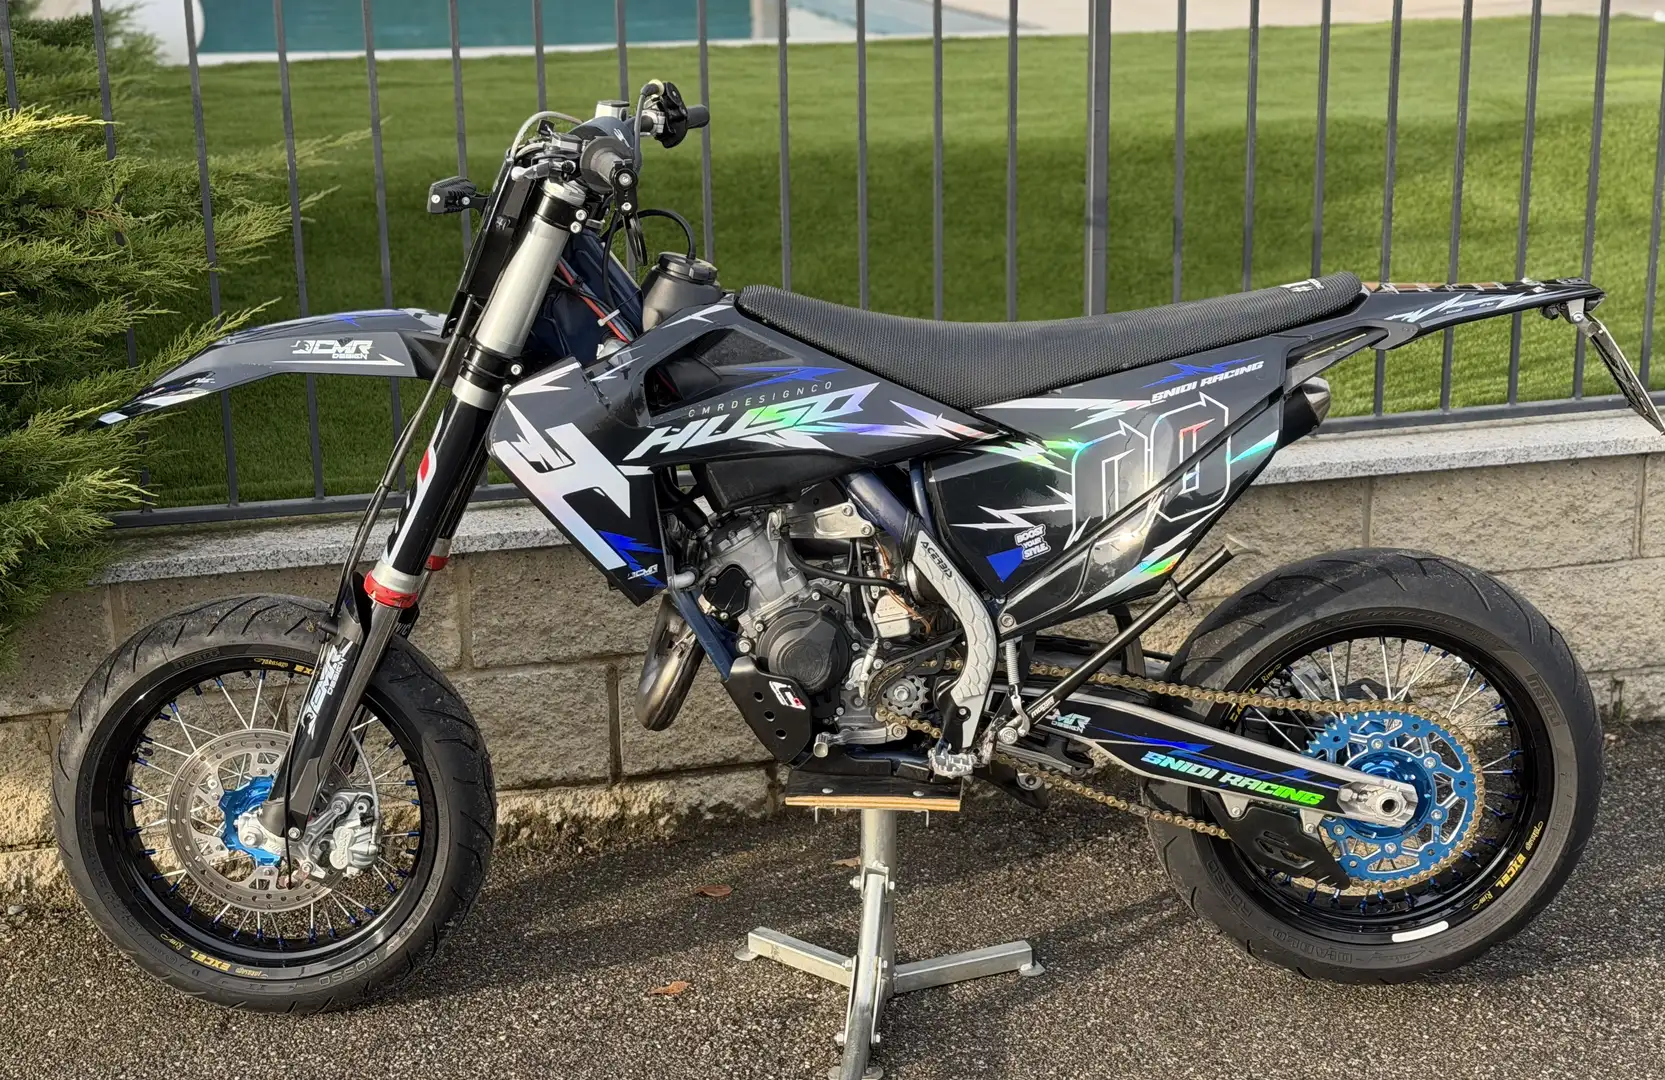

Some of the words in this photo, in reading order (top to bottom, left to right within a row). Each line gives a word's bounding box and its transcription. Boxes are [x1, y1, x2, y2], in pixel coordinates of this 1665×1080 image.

[1200, 360, 1265, 387] RACING
[1016, 525, 1044, 543] BOOST
[1023, 537, 1041, 548] YOUR
[1140, 751, 1217, 779] SNIDI
[1219, 773, 1326, 805] RACING
[1495, 852, 1526, 889] EXCEL
[190, 949, 231, 972] EXCEL
[320, 952, 379, 986] ROSSO
